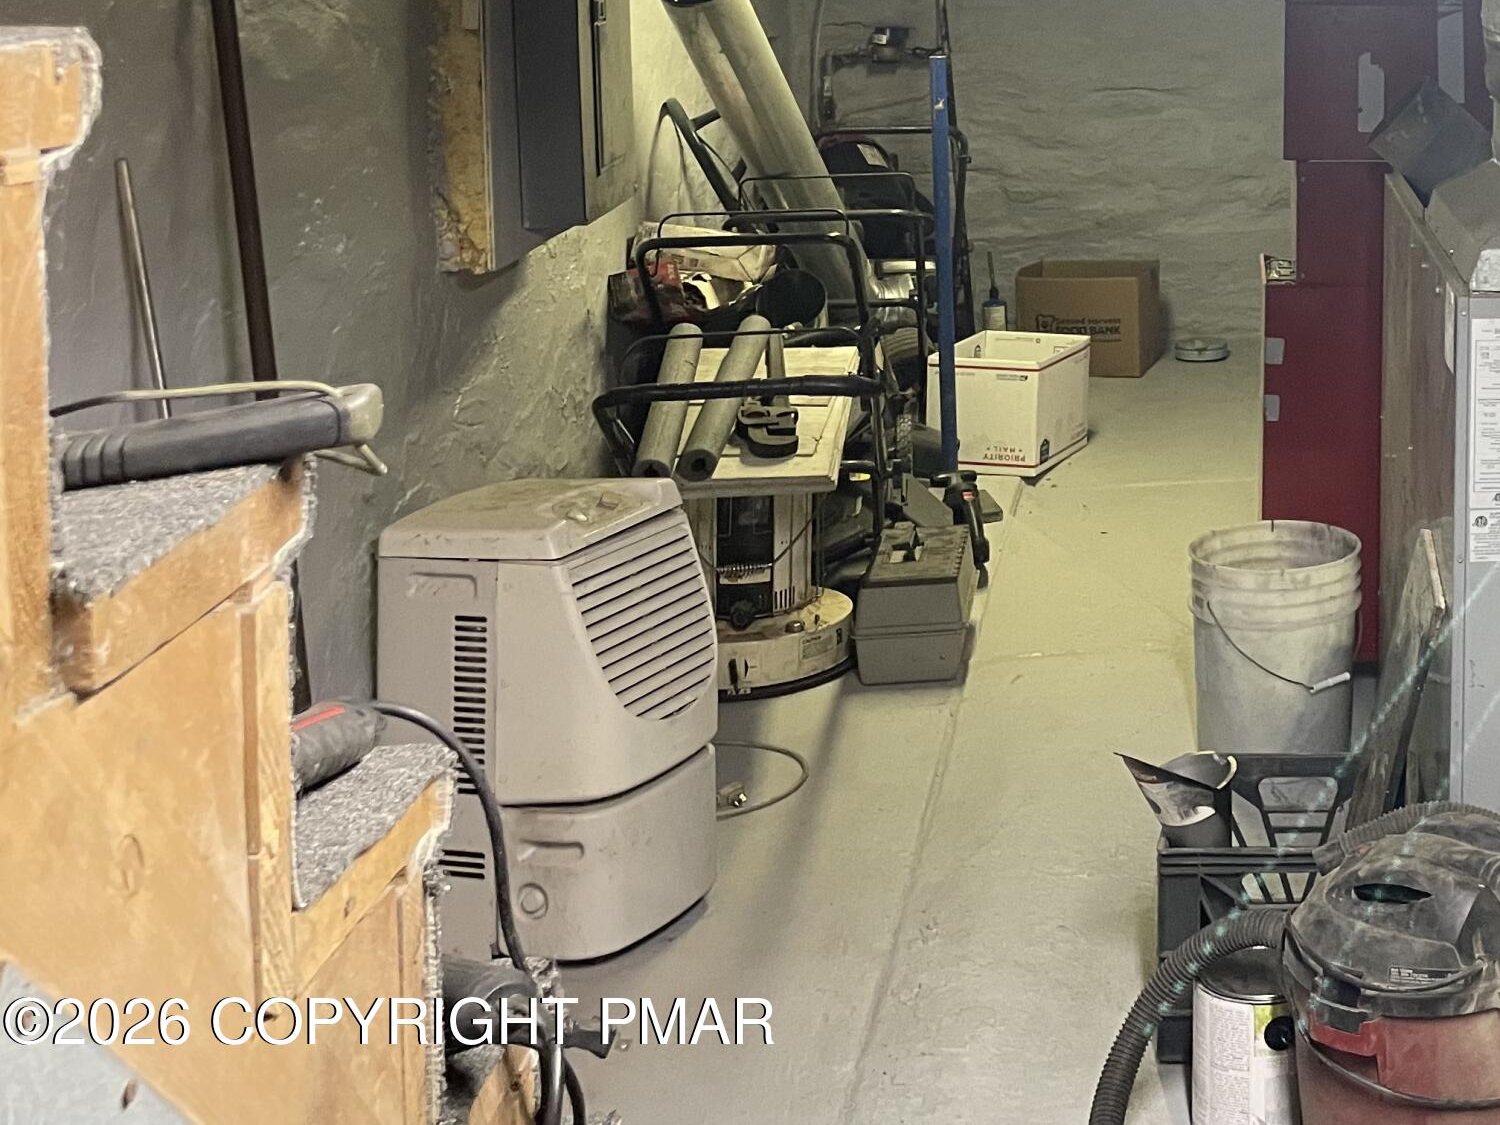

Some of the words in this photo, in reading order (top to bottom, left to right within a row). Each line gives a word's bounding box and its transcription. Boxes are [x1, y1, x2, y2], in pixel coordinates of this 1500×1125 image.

[1089, 325, 1121, 335] BANK
[993, 446, 1016, 454] MAIL
[983, 453, 1026, 462] PRIORITY
